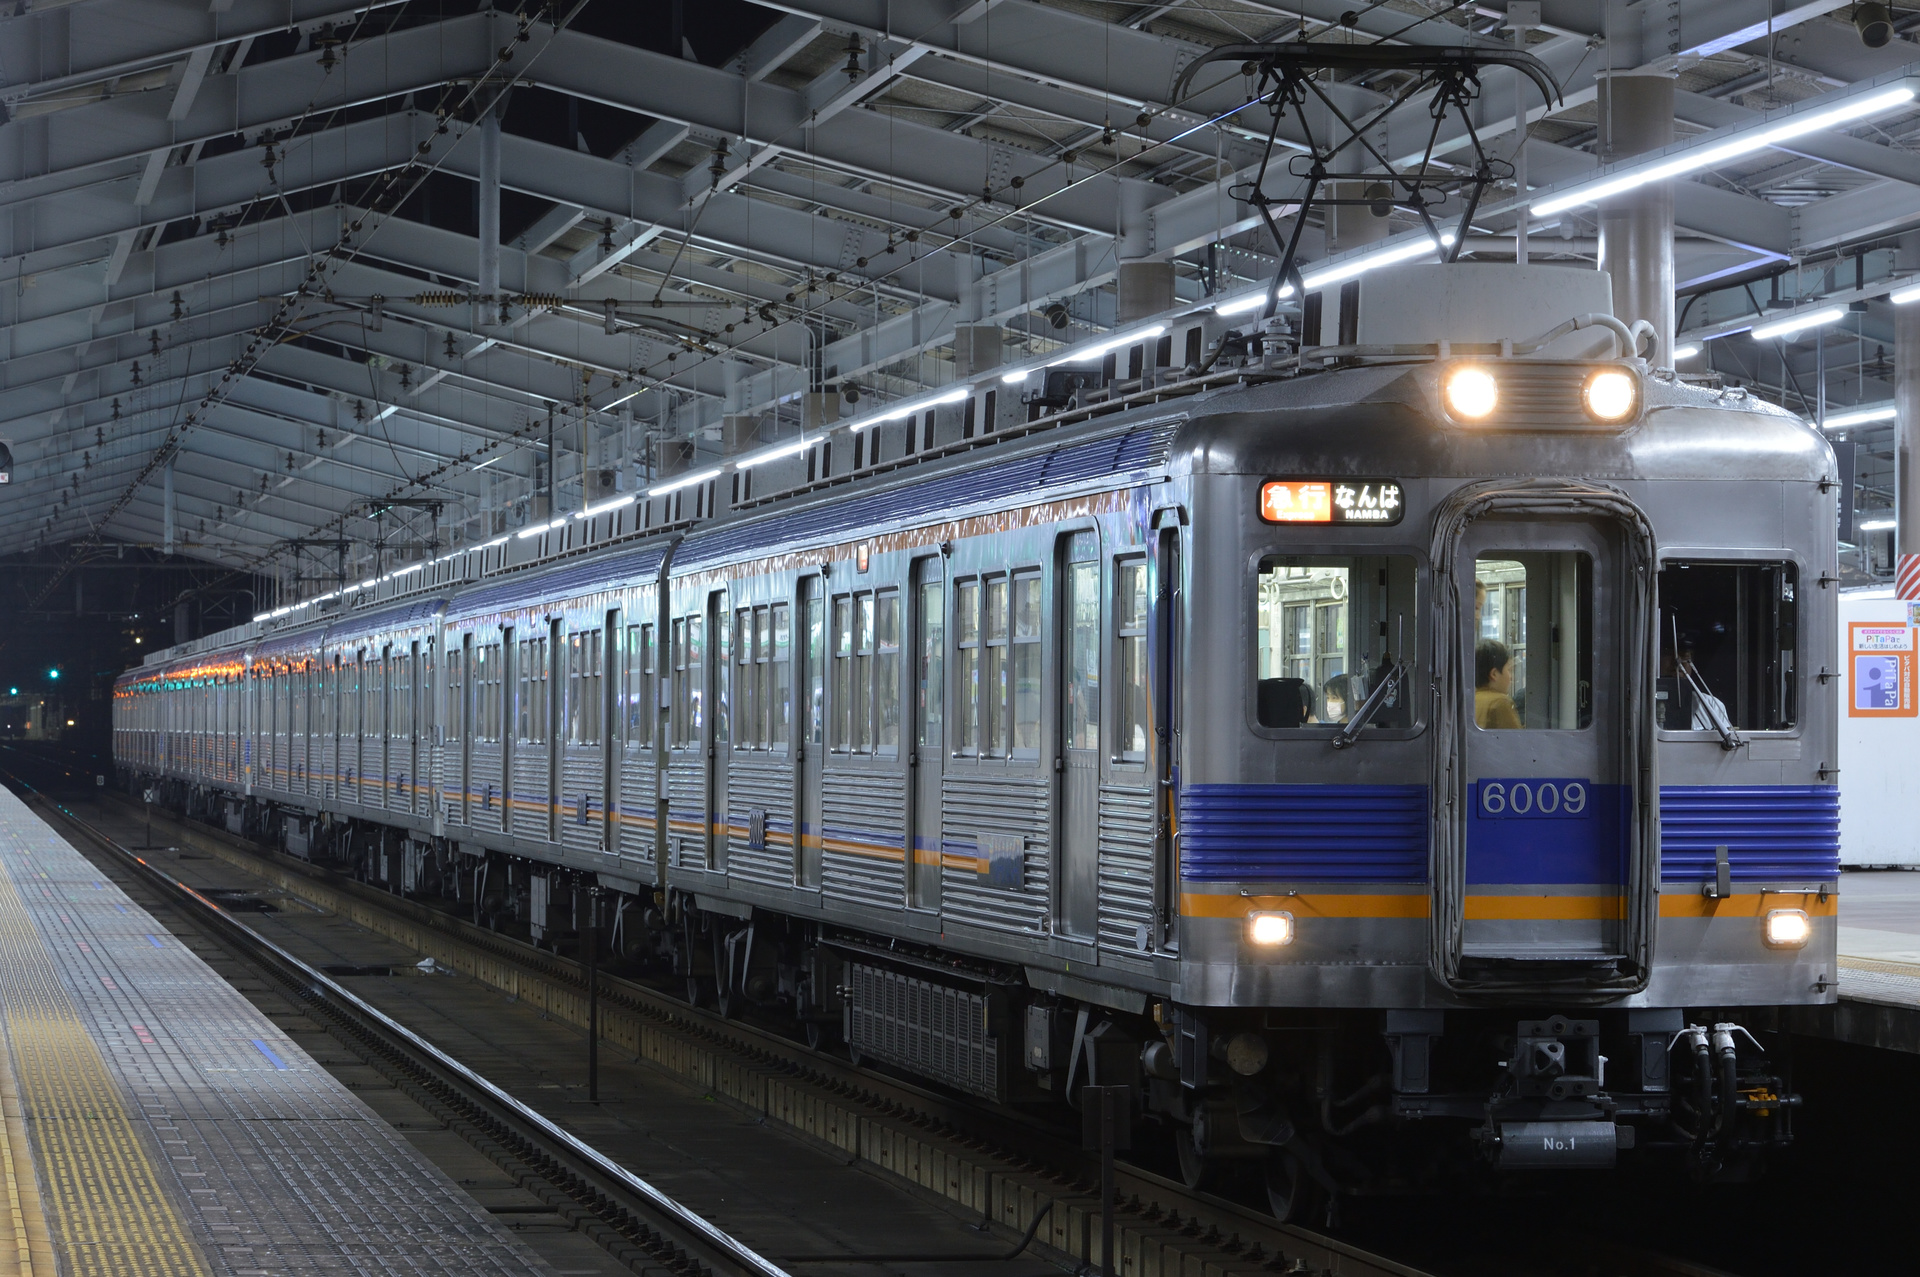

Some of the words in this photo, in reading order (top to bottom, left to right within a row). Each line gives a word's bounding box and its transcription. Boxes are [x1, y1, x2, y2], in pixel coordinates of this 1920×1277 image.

[1266, 485, 1326, 510] 急行
[1335, 485, 1399, 509] なんば
[1345, 509, 1389, 519] NAMBA
[1884, 659, 1897, 706] PiTaPa
[1482, 782, 1586, 814] 6009
[1543, 1137, 1575, 1150] No.1
